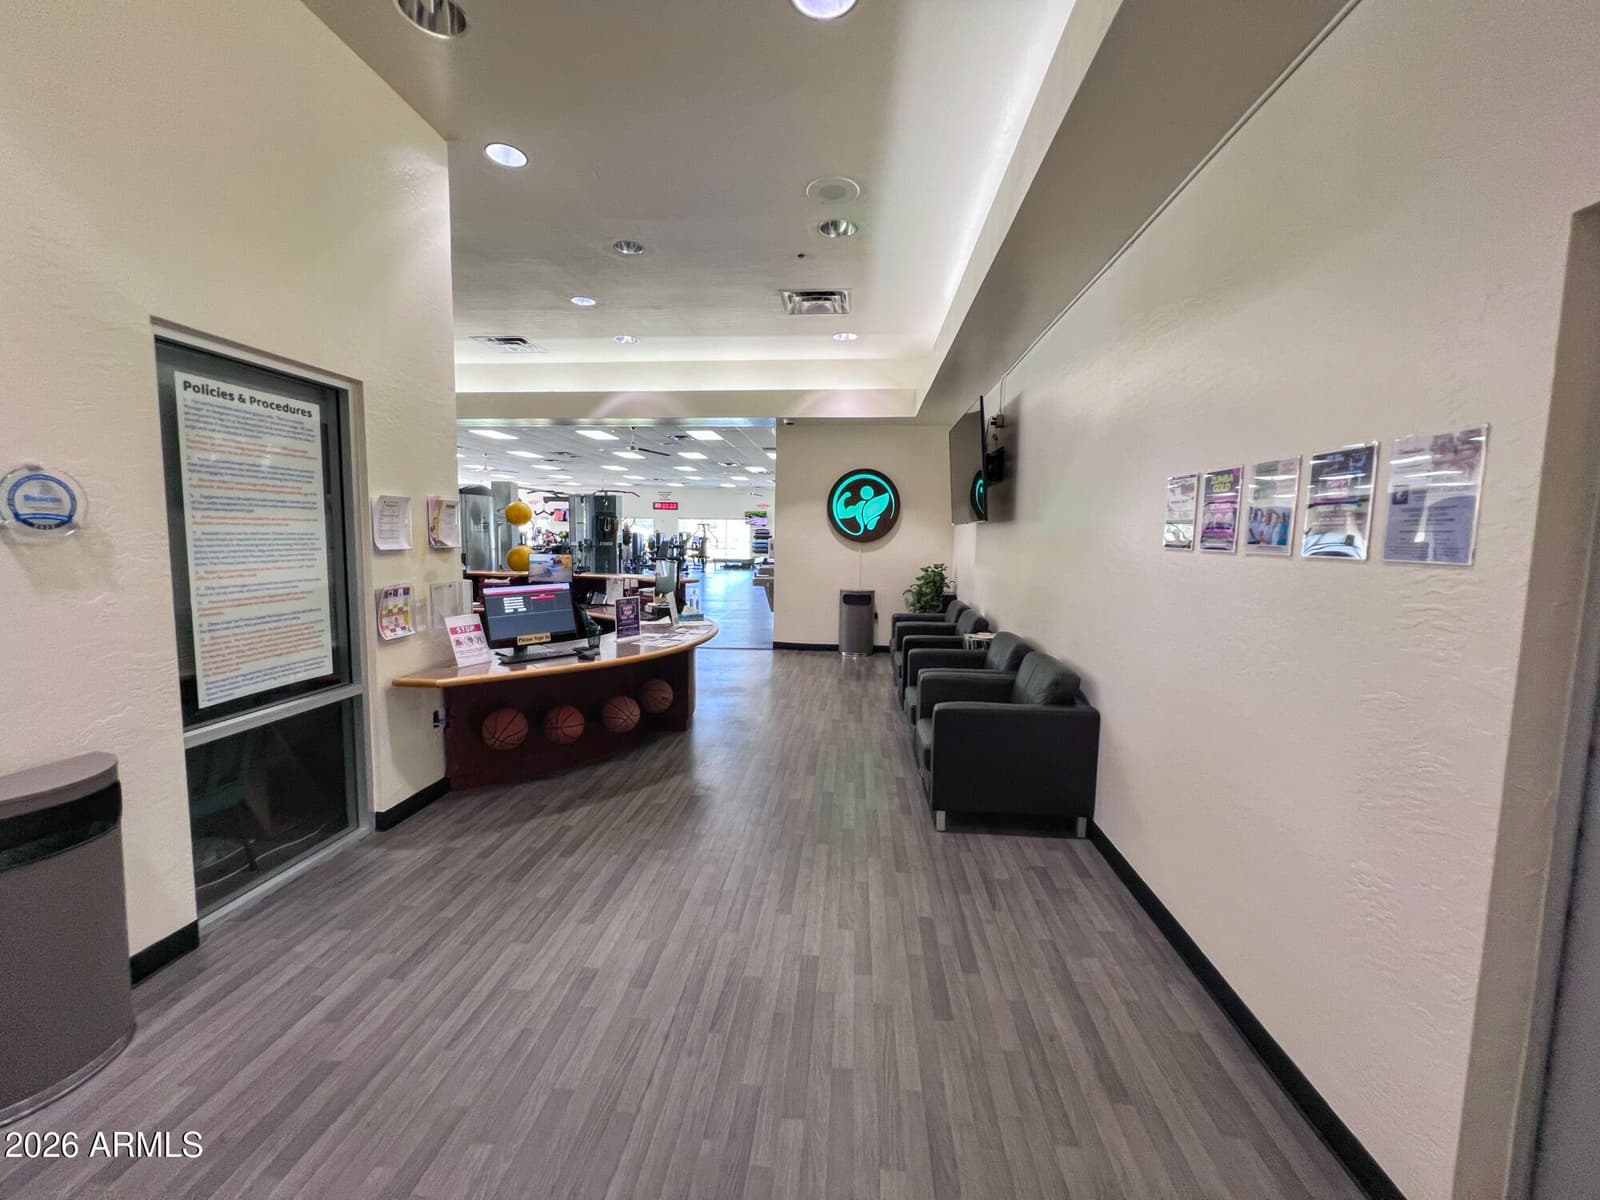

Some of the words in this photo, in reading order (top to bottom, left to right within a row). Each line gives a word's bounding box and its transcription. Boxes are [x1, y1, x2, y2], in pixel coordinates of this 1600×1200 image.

[183, 380, 235, 402] Policies
[238, 394, 247, 404] &
[250, 396, 313, 418] Procedures
[456, 625, 475, 634] STOP
